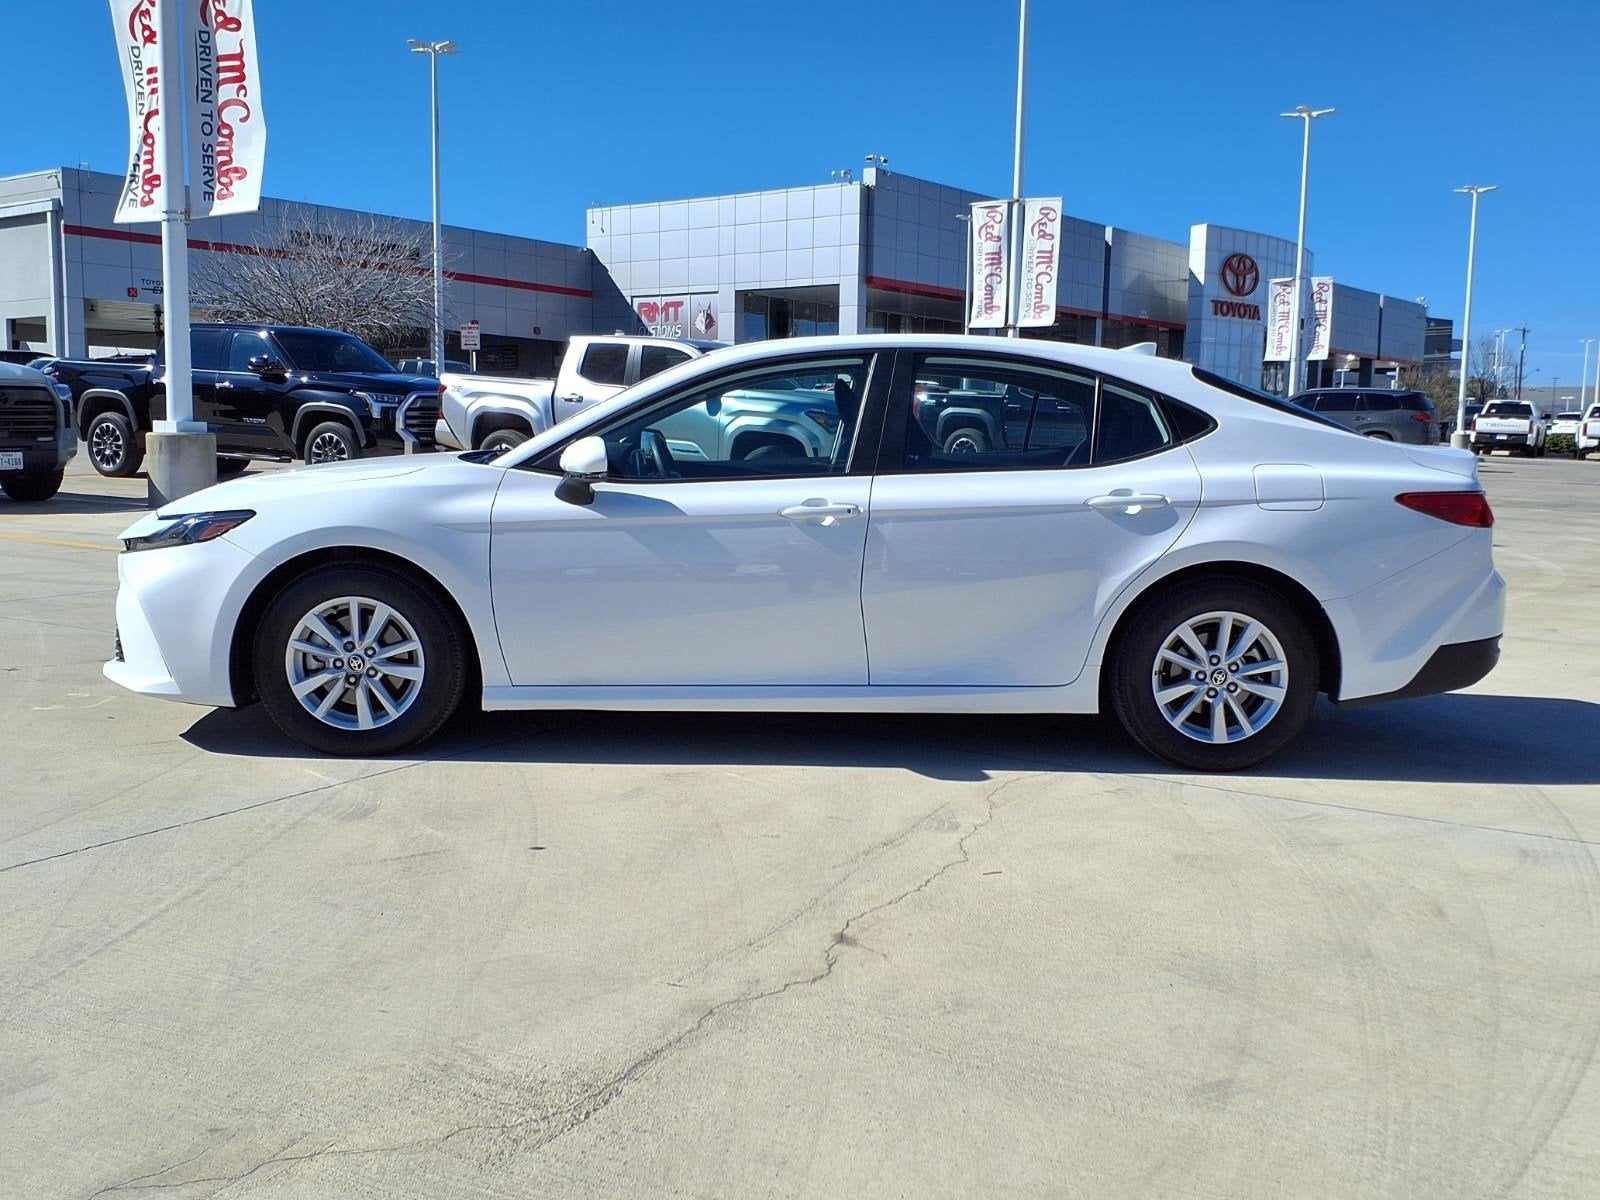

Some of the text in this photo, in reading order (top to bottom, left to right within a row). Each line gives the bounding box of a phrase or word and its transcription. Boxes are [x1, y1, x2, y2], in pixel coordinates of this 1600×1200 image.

[129, 45, 145, 116] DRIVEN
[199, 30, 214, 202] DRIVEN TO SERVE
[216, 38, 251, 201] McCombs
[977, 208, 1003, 320] Red McCombs
[1031, 206, 1057, 319] Red McCombs
[1211, 300, 1261, 320] TOYOTA
